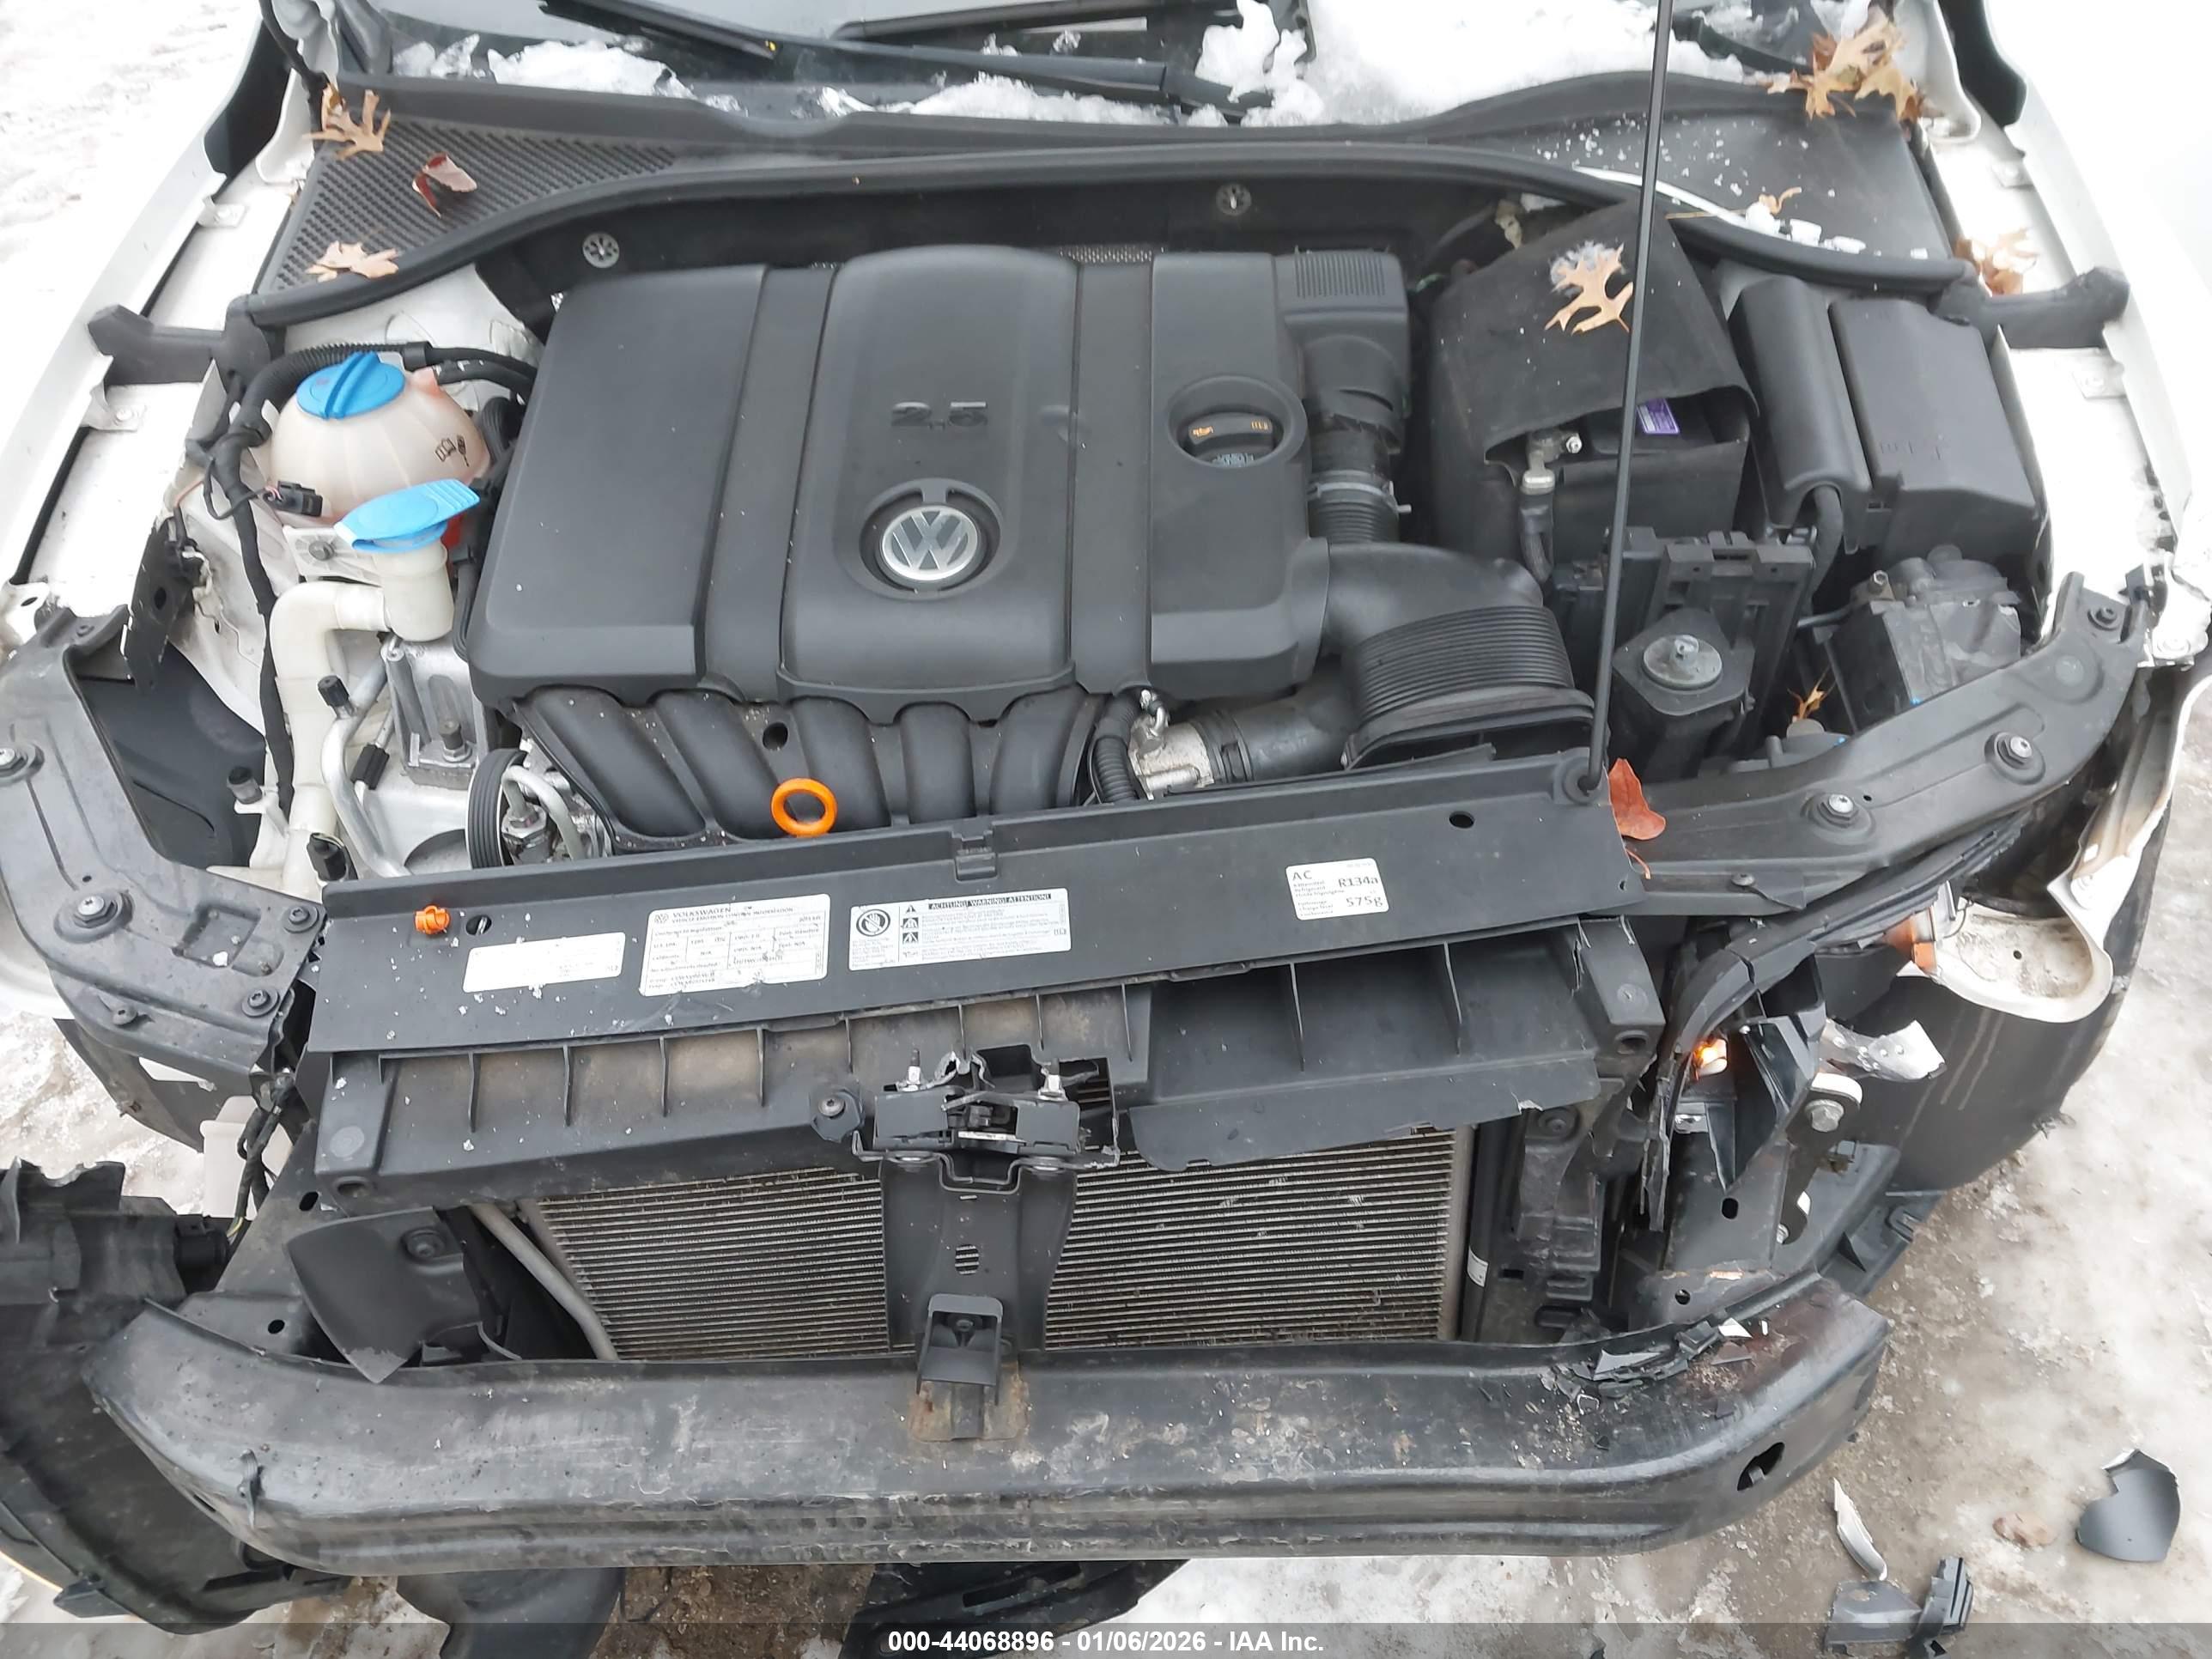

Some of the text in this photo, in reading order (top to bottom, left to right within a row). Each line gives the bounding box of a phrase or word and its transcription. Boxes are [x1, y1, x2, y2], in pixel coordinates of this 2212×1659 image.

[1292, 870, 1312, 881] AC
[1338, 875, 1378, 887] R134a
[672, 907, 732, 918] VOLKSWAGEN
